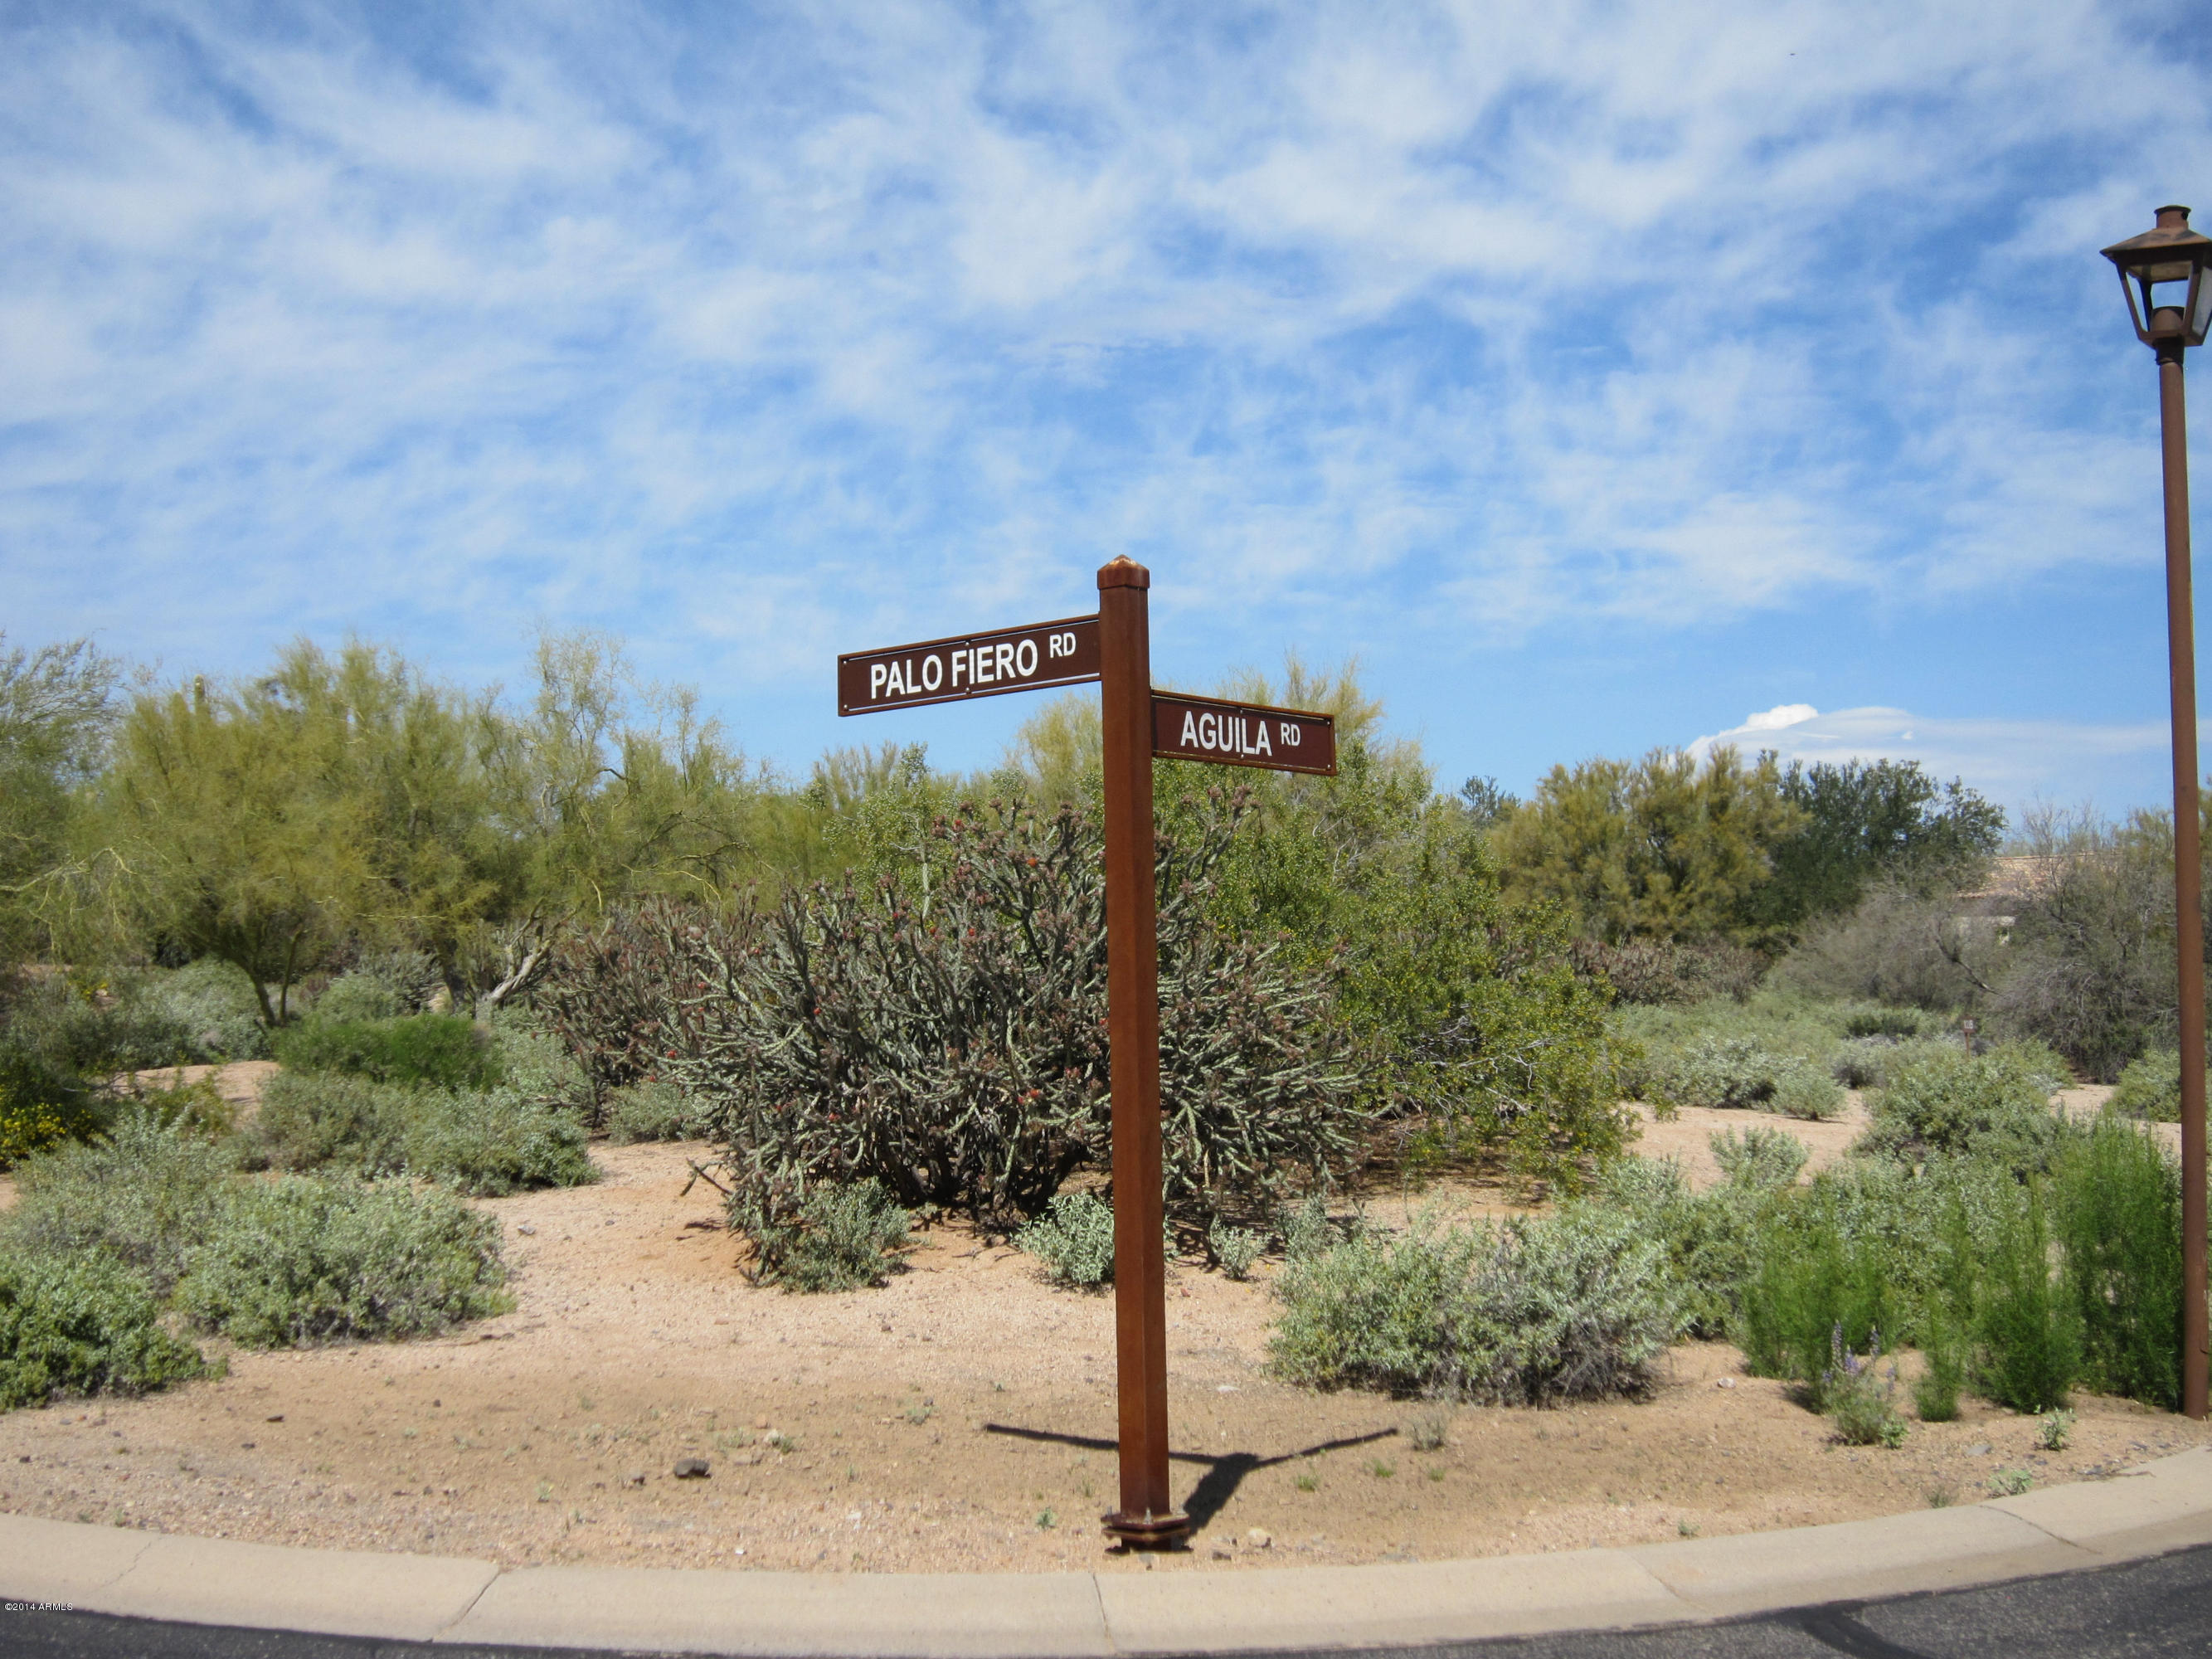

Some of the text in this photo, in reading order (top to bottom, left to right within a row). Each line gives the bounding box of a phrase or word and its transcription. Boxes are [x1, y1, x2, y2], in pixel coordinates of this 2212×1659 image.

[871, 632, 1077, 699] PALO FIERO RD
[1180, 710, 1301, 757] AGUILA RD
